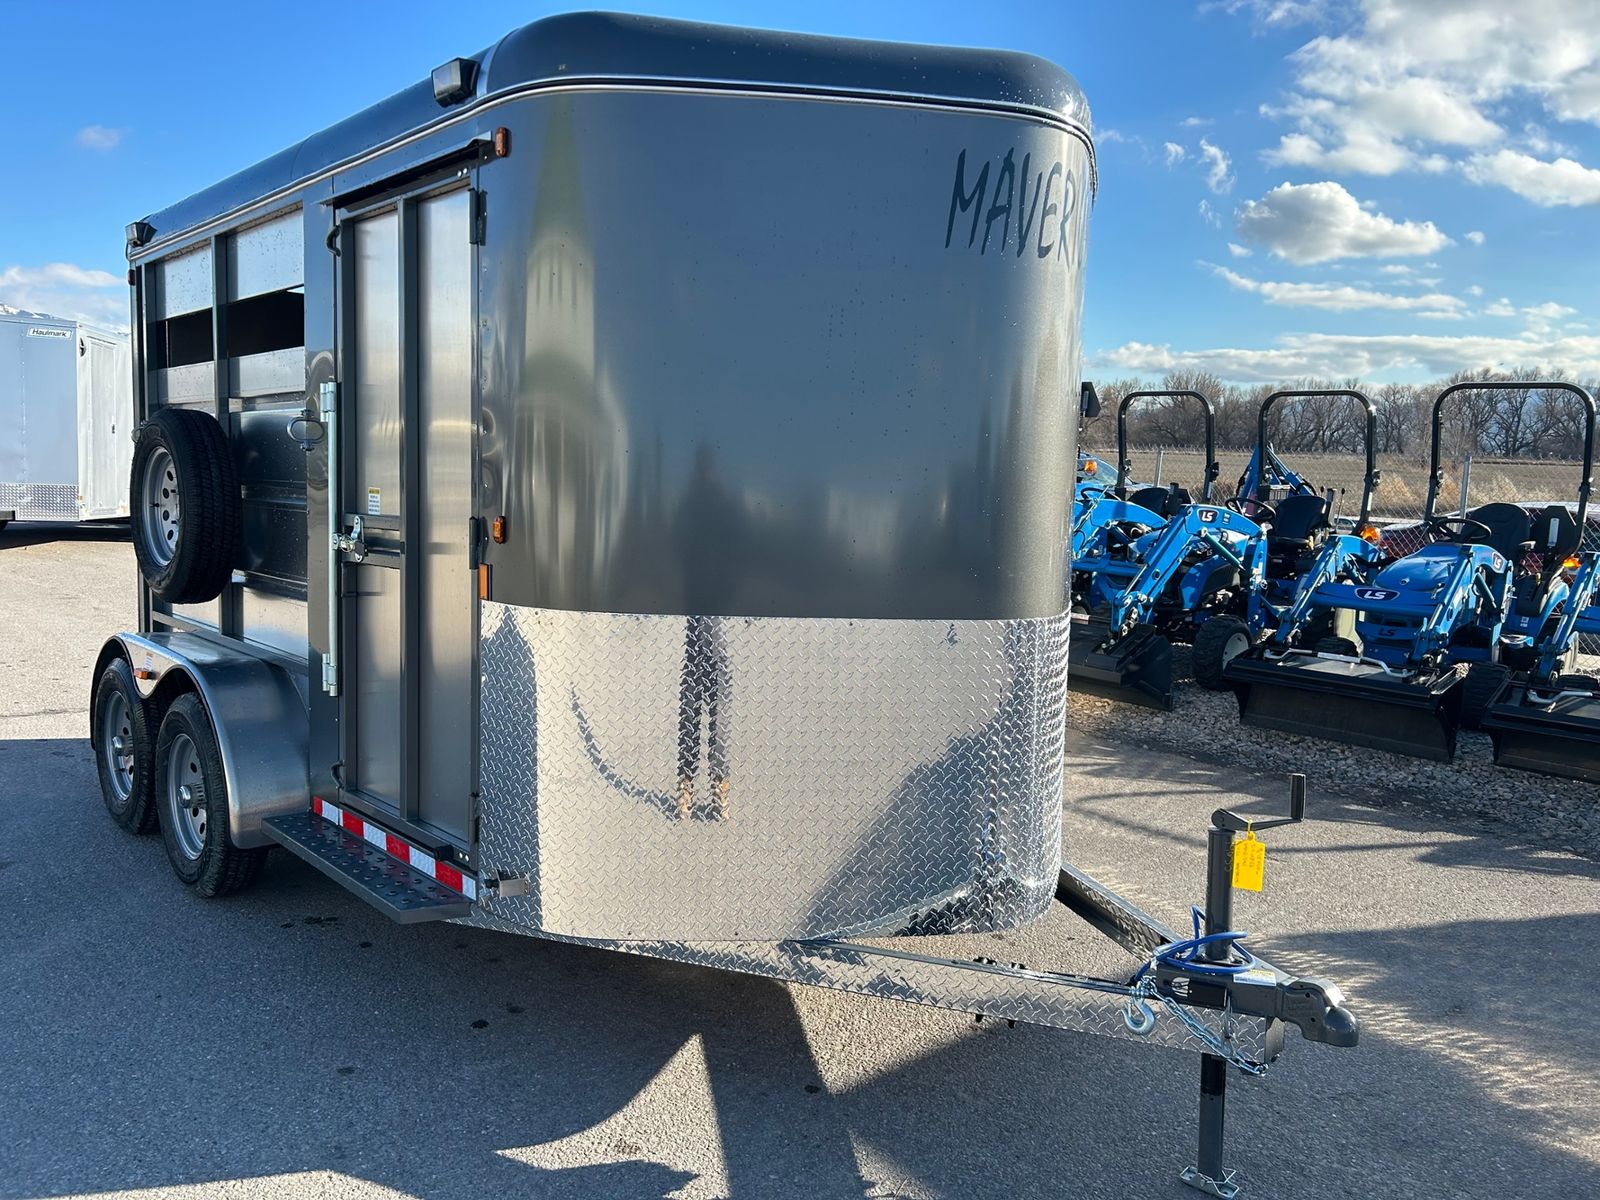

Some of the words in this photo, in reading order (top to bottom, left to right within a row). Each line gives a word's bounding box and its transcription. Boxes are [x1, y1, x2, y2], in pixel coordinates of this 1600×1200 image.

[32, 328, 67, 337] Haulmark
[1201, 511, 1214, 522] LS
[1493, 556, 1502, 569] LS
[1363, 590, 1387, 600] LS
[1379, 628, 1398, 637] LS
